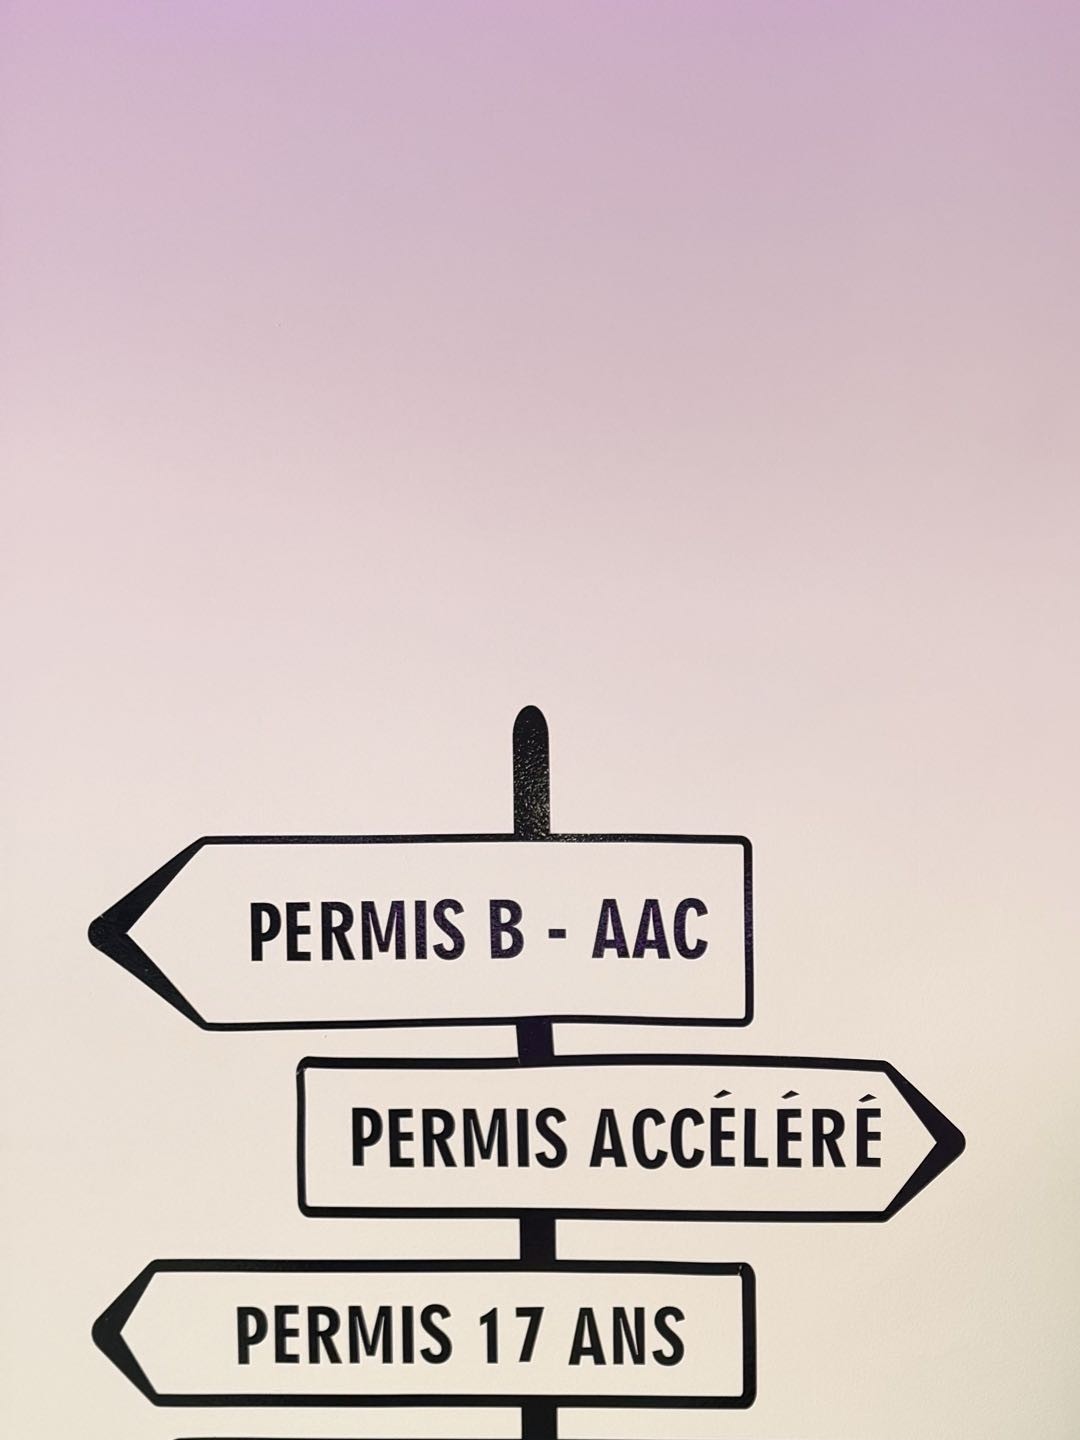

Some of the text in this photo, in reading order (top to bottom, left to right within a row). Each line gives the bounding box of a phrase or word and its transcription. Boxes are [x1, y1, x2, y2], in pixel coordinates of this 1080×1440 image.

[250, 897, 708, 962] PERMIS B - AAC
[351, 1089, 882, 1170] PERMIS ACCÉLÉRÉ
[236, 1303, 685, 1367] PERMIS 17 ANS
